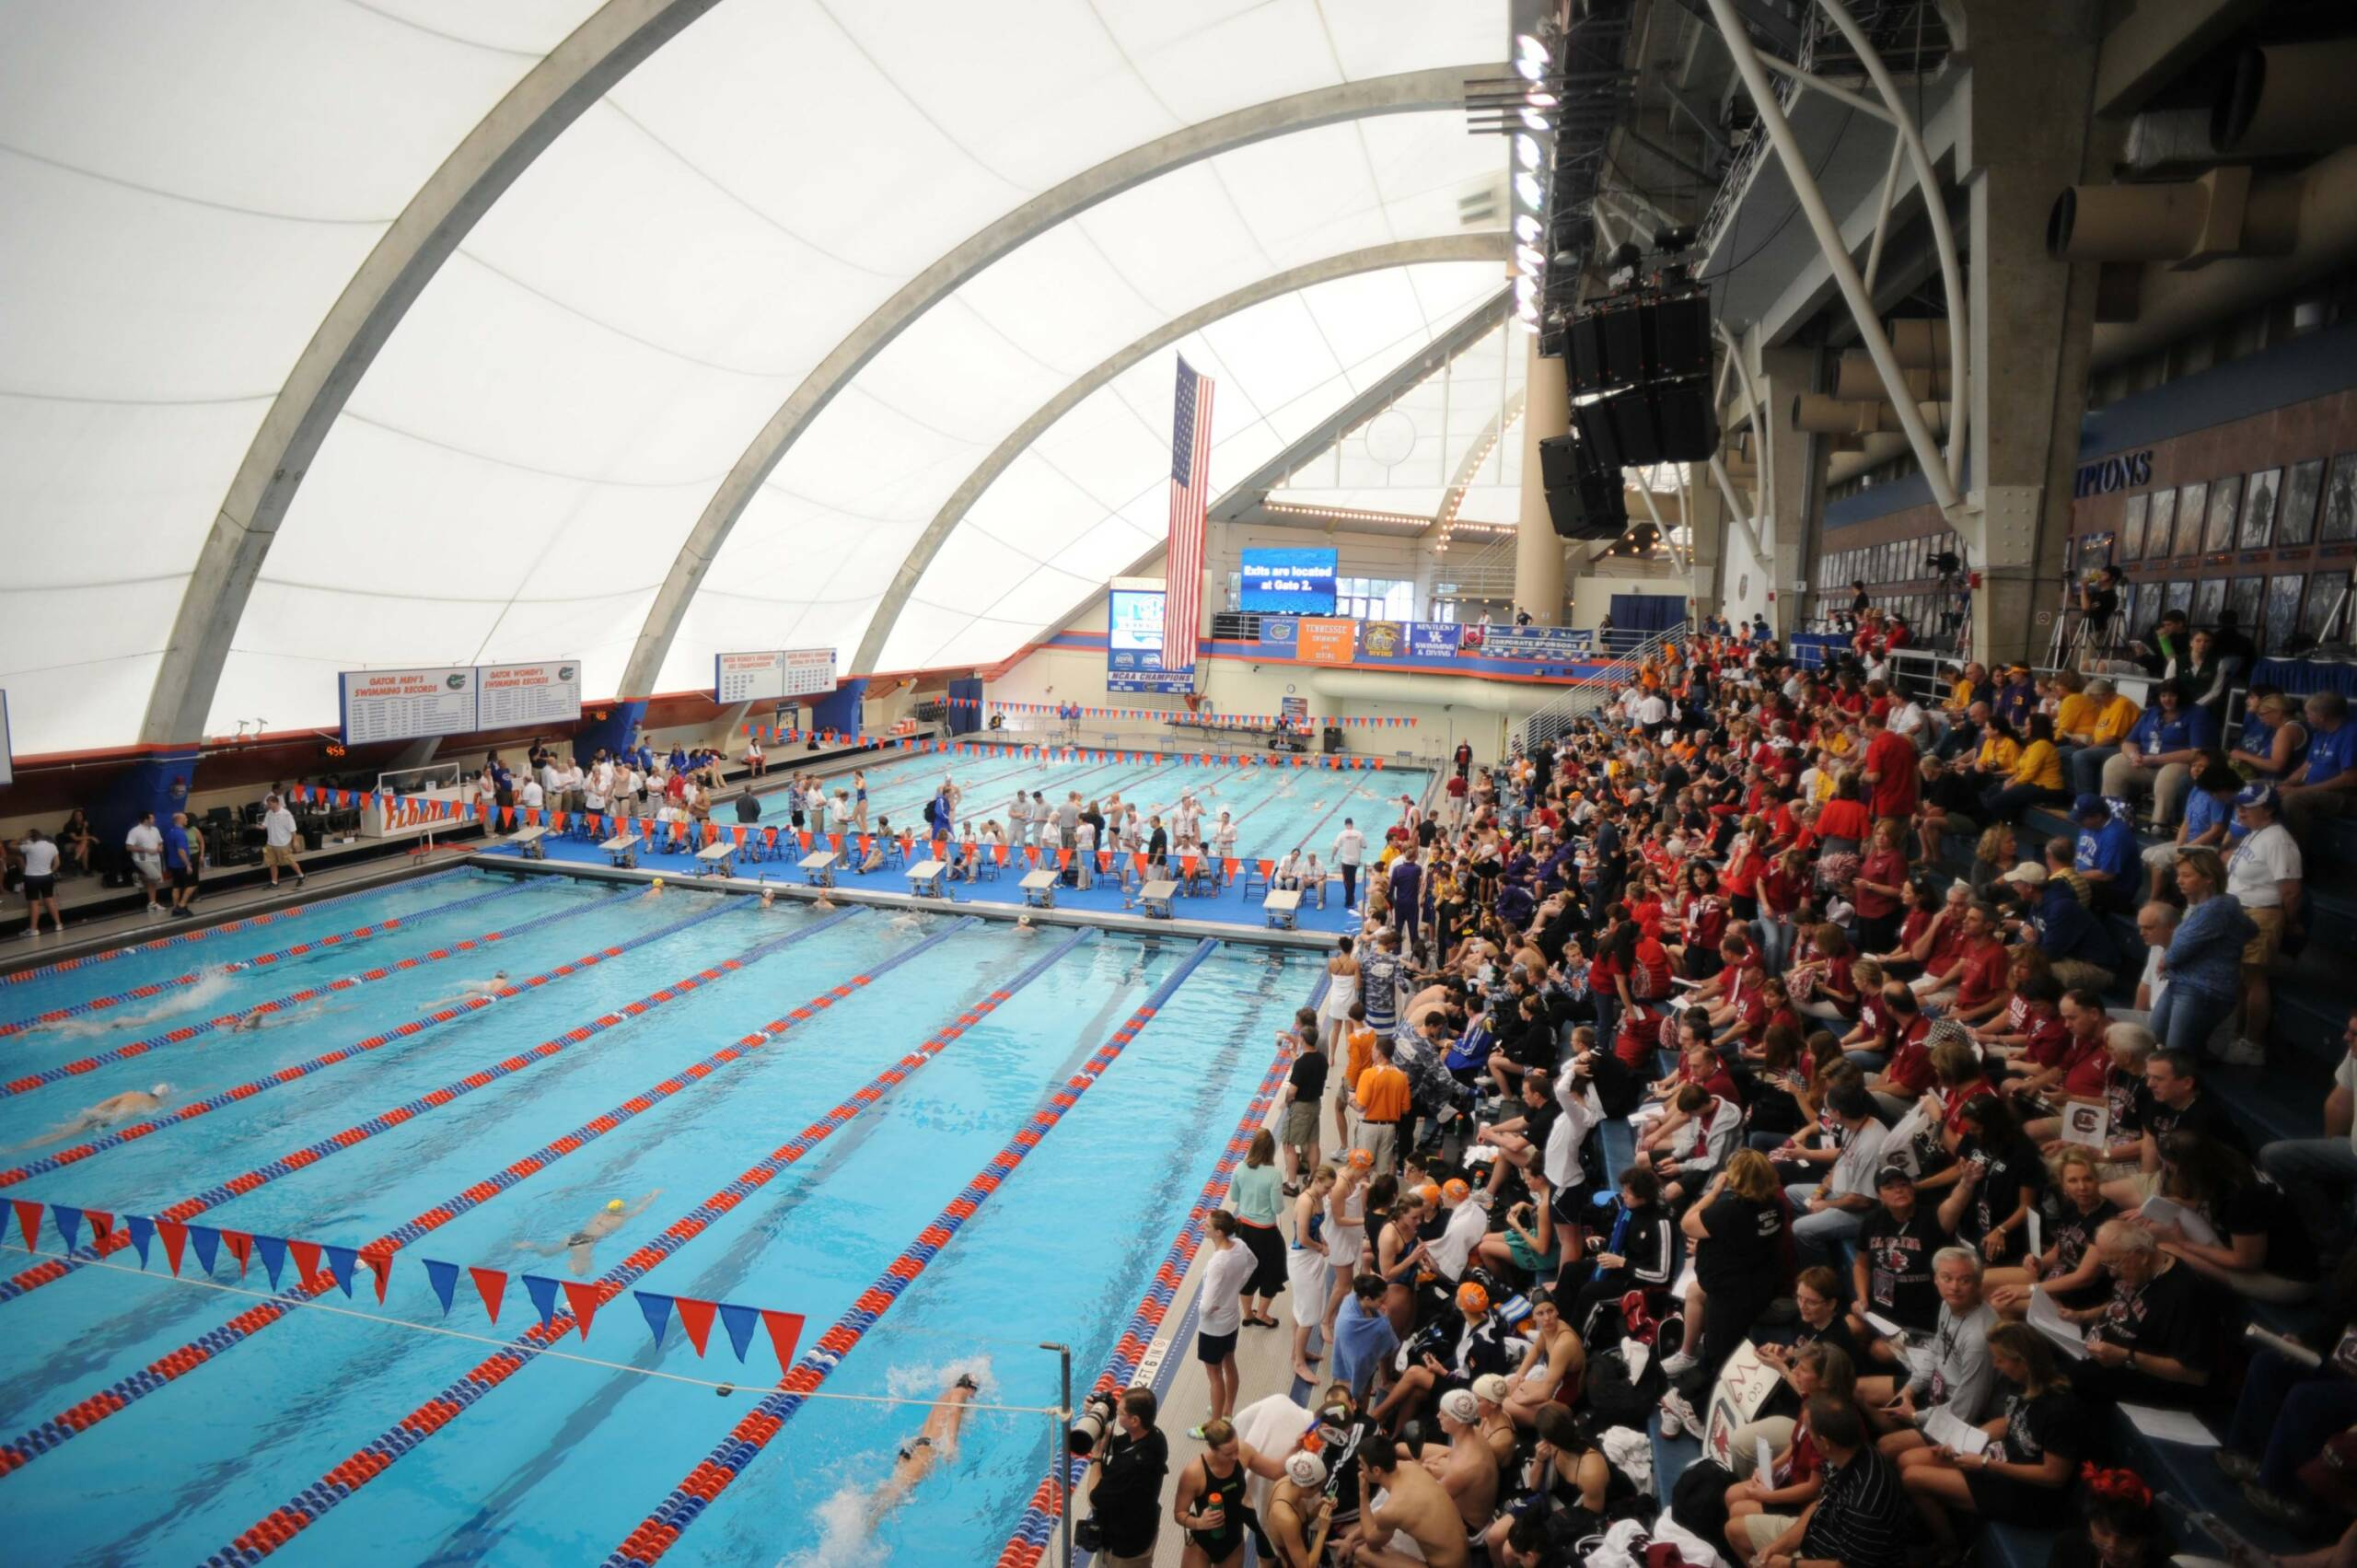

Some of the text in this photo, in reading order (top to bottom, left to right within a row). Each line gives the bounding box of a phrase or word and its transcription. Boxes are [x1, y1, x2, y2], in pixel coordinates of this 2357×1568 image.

[2073, 450, 2153, 499] PIONS
[1244, 565, 1332, 577] Exits are located
[1261, 580, 1312, 591] at Gate 2.
[1306, 624, 1348, 634] TENNESSEE
[1416, 623, 1455, 632] KENTUCKY
[1491, 638, 1577, 649] CORPORATE SPONSORS
[490, 668, 544, 679] GATOR WOMEN'S
[1111, 672, 1191, 682] NCAA CHAMPIONS
[369, 676, 424, 686] GATOR MEN'S
[483, 677, 550, 690] SWIMMING RECORDS
[354, 685, 438, 698] SWIMMING RECORDS
[1138, 1368, 1154, 1379] FT
[1148, 1349, 1164, 1359] IN
